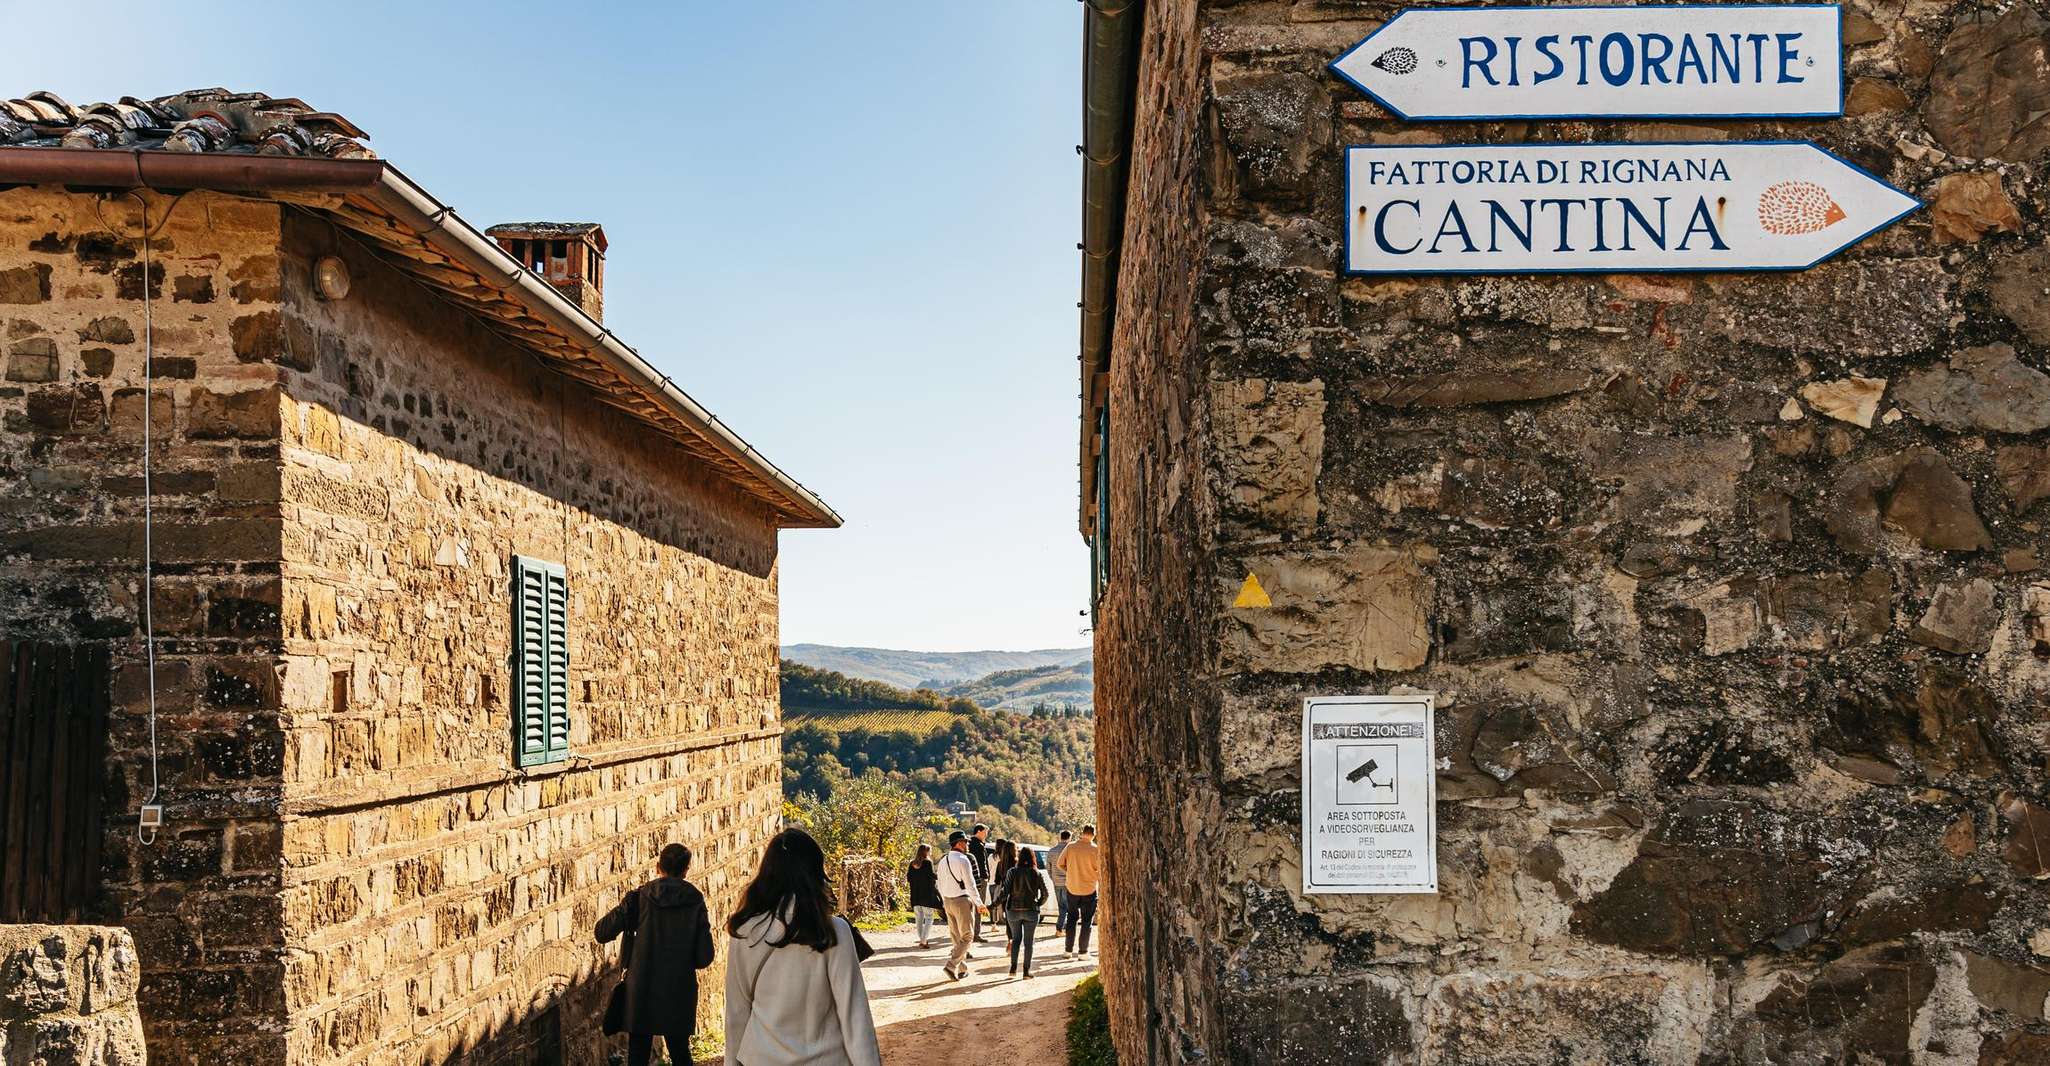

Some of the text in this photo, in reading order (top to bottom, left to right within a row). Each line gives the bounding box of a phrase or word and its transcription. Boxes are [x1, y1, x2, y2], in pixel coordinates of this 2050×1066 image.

[1459, 32, 1805, 89] RISTORANTE
[1369, 158, 1732, 185] FATTORIA DI RIGNANA
[1374, 196, 1731, 255] CANTINA
[1325, 725, 1413, 737] ATTENZIONE!
[1327, 811, 1406, 821] AREA SOTTOPOSTA
[1319, 824, 1415, 834] A VIDEOSORVEGLIANZA
[1358, 837, 1375, 846] PER
[1321, 849, 1413, 860] RAGIONI DI SICUREZZA
